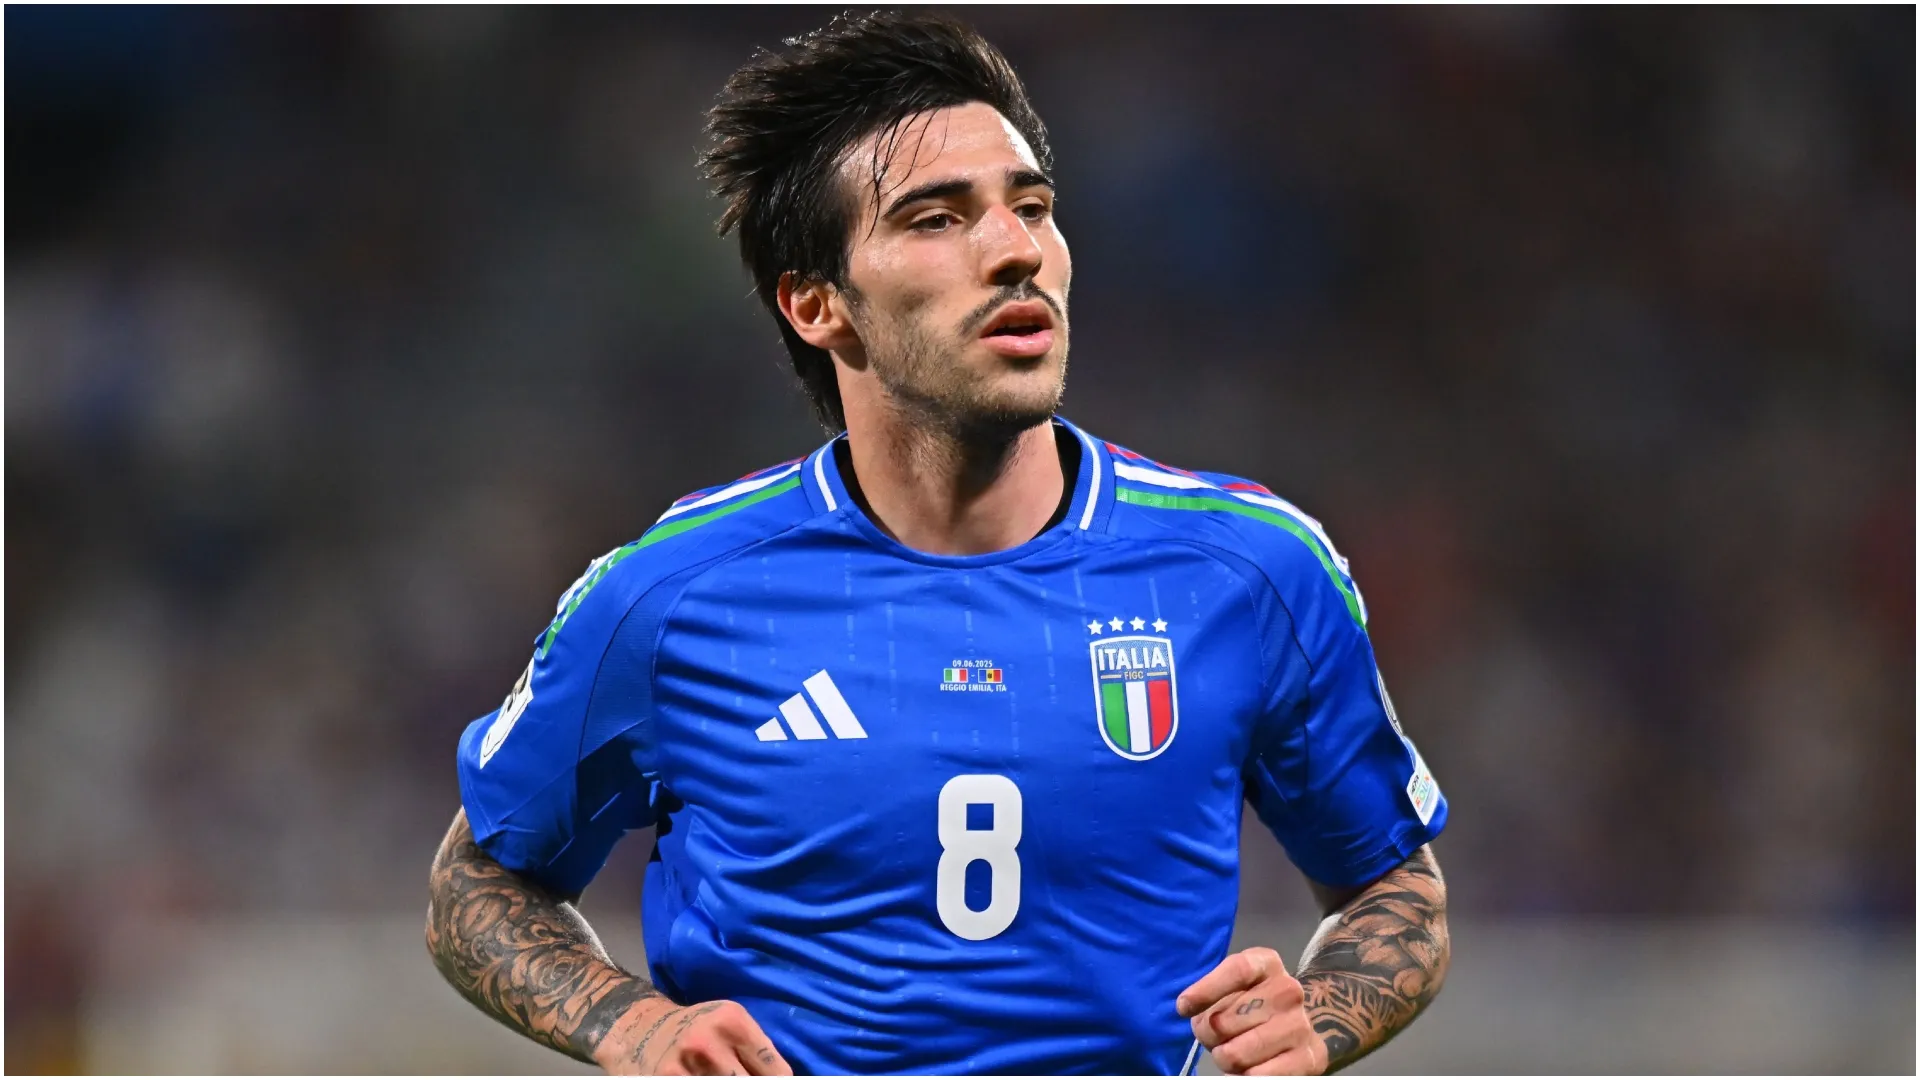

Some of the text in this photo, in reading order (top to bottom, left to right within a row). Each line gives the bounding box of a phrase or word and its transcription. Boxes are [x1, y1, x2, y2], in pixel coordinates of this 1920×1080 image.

[952, 659, 993, 668] 09.06.2025
[1098, 646, 1167, 671] ITALIA
[1124, 670, 1144, 680] FIGC
[940, 683, 1007, 693] REGGIO EMILIA, ITA
[936, 774, 1023, 941] 8
